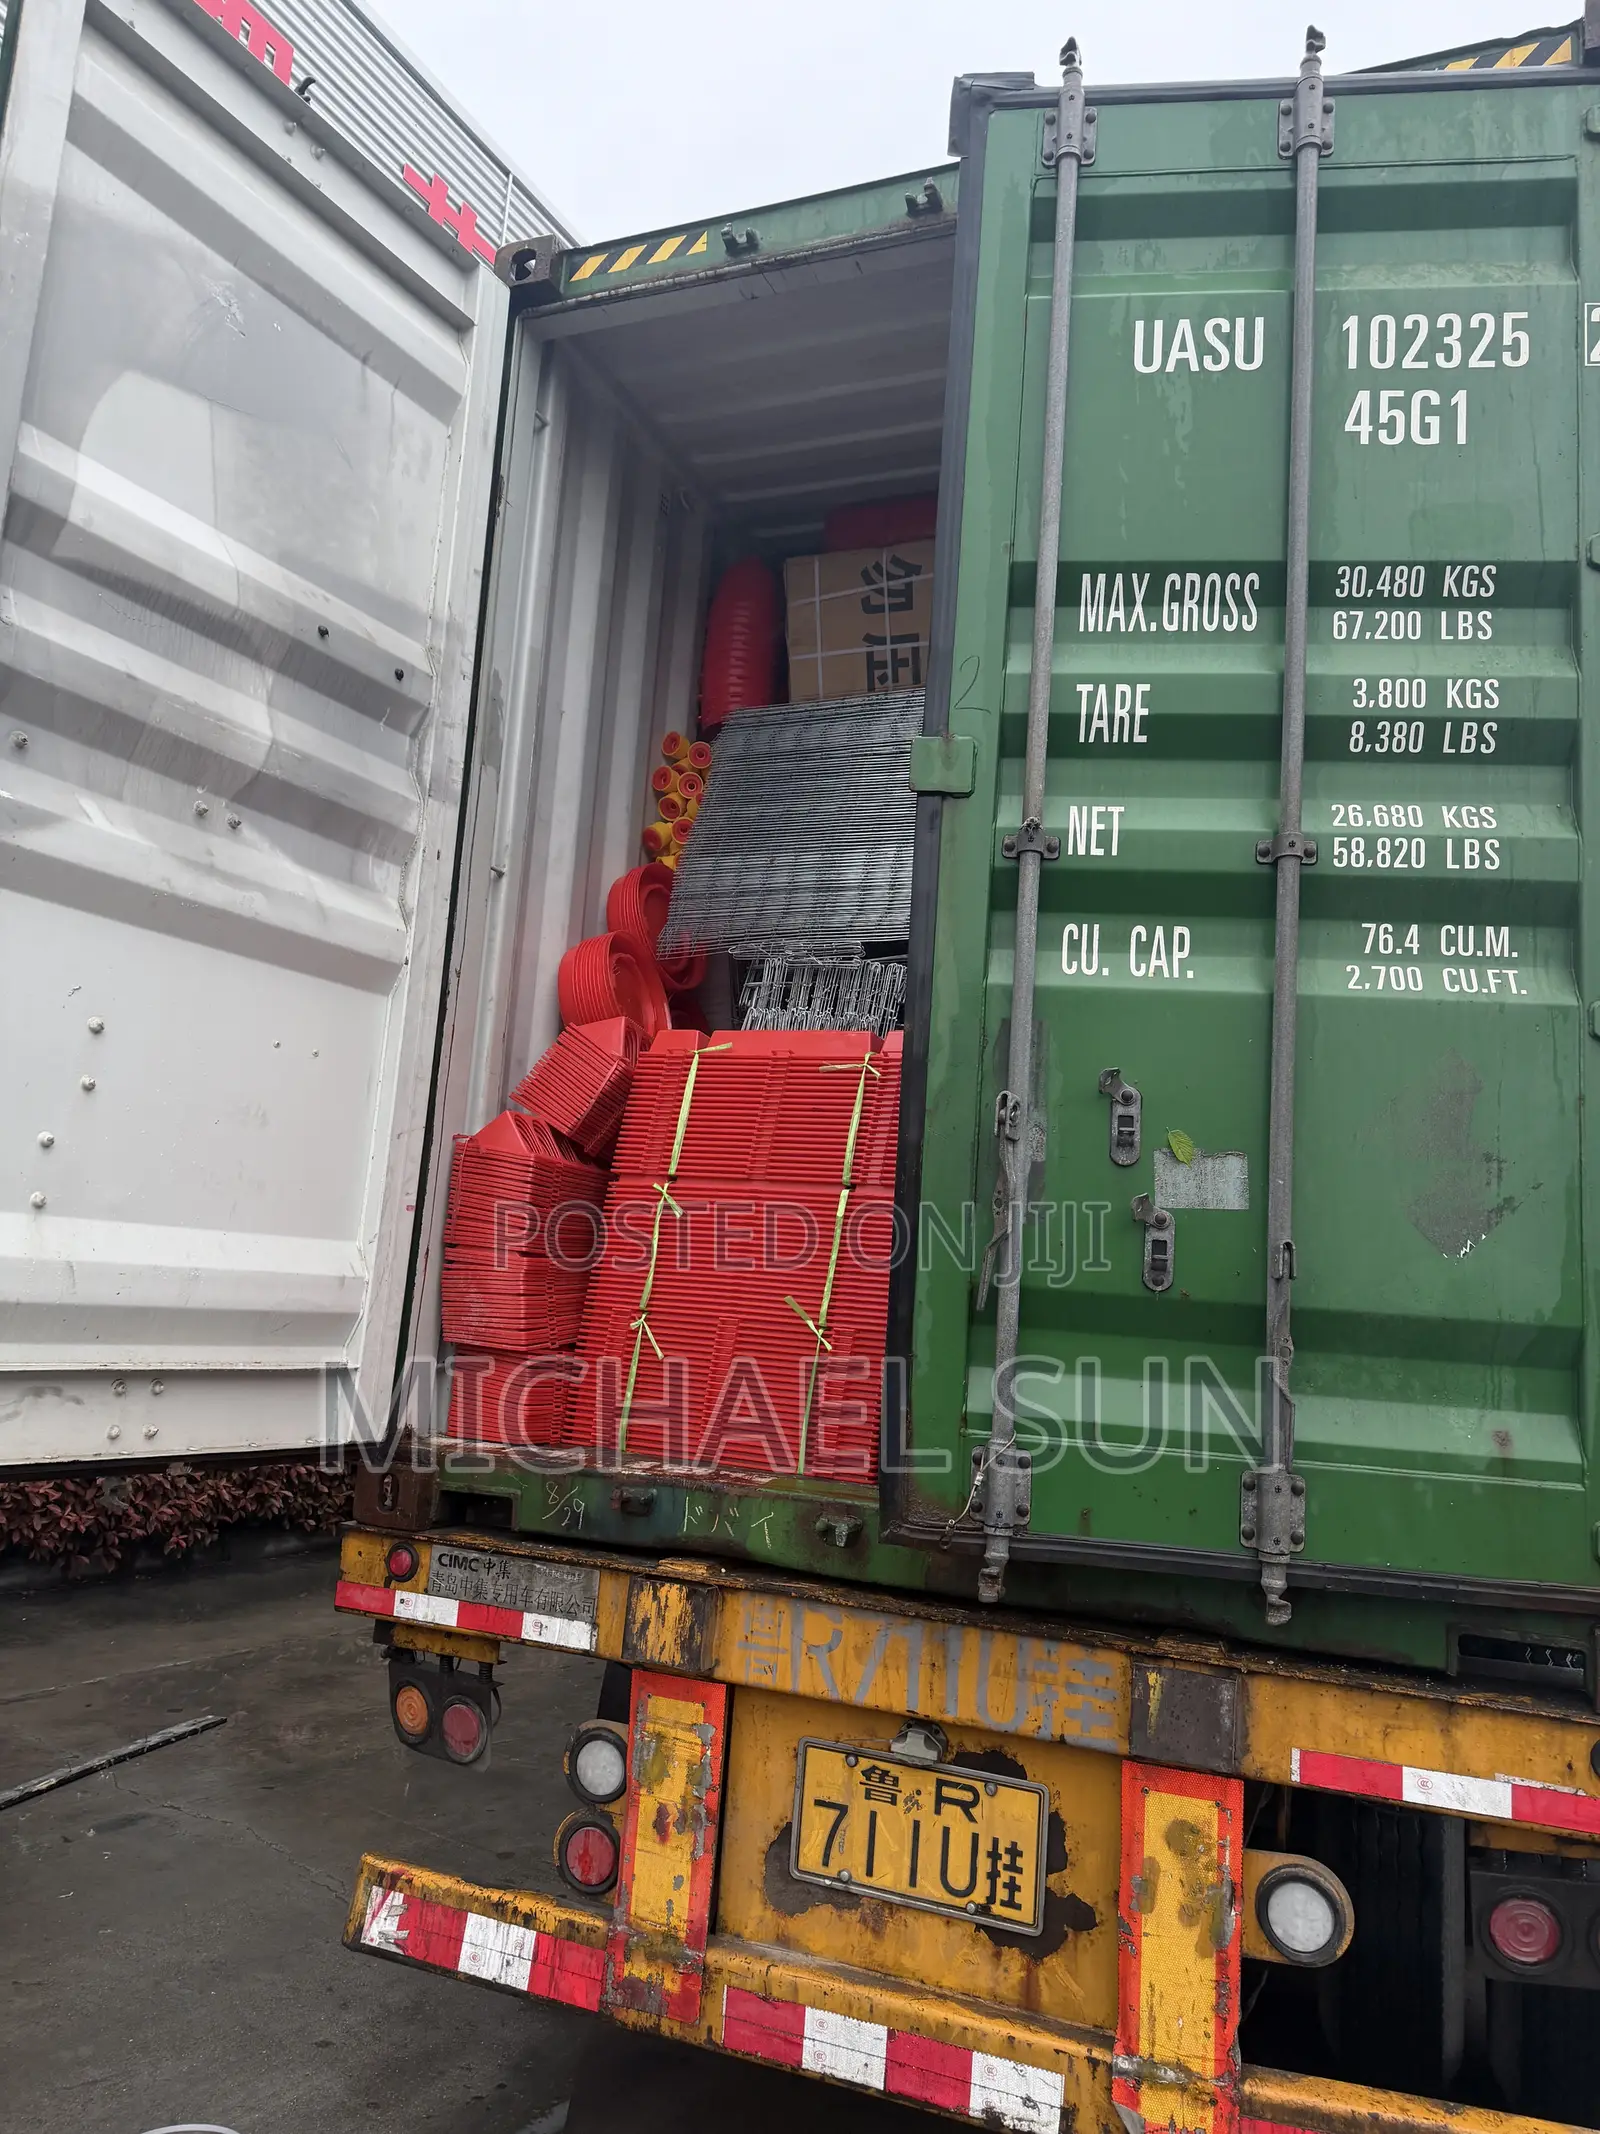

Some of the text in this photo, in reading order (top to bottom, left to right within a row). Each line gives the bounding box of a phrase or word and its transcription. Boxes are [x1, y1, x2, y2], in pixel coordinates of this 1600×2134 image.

[1132, 316, 1265, 373] UASU
[1340, 311, 1531, 370] 102325
[1343, 389, 1469, 445] 45G1
[1078, 564, 1497, 632] MAX.GROSS 30,480 KGS
[1332, 610, 1493, 640] 67,200 LBS
[1076, 678, 1500, 743] TARE 3,800 KGS
[1349, 720, 1498, 754] 8,380 LBS
[1067, 805, 1125, 856] NET
[1441, 805, 1498, 829] KGS
[1333, 837, 1500, 870] 58,820 LBS
[1061, 923, 1519, 979] CU. CAP. 76.4 CU.M.
[1442, 967, 1528, 995] CU.FT.
[437, 1553, 480, 1573] CIMC
[483, 1557, 512, 1581] 中集
[430, 1570, 598, 1620] 青岛中集专用车有限公司
